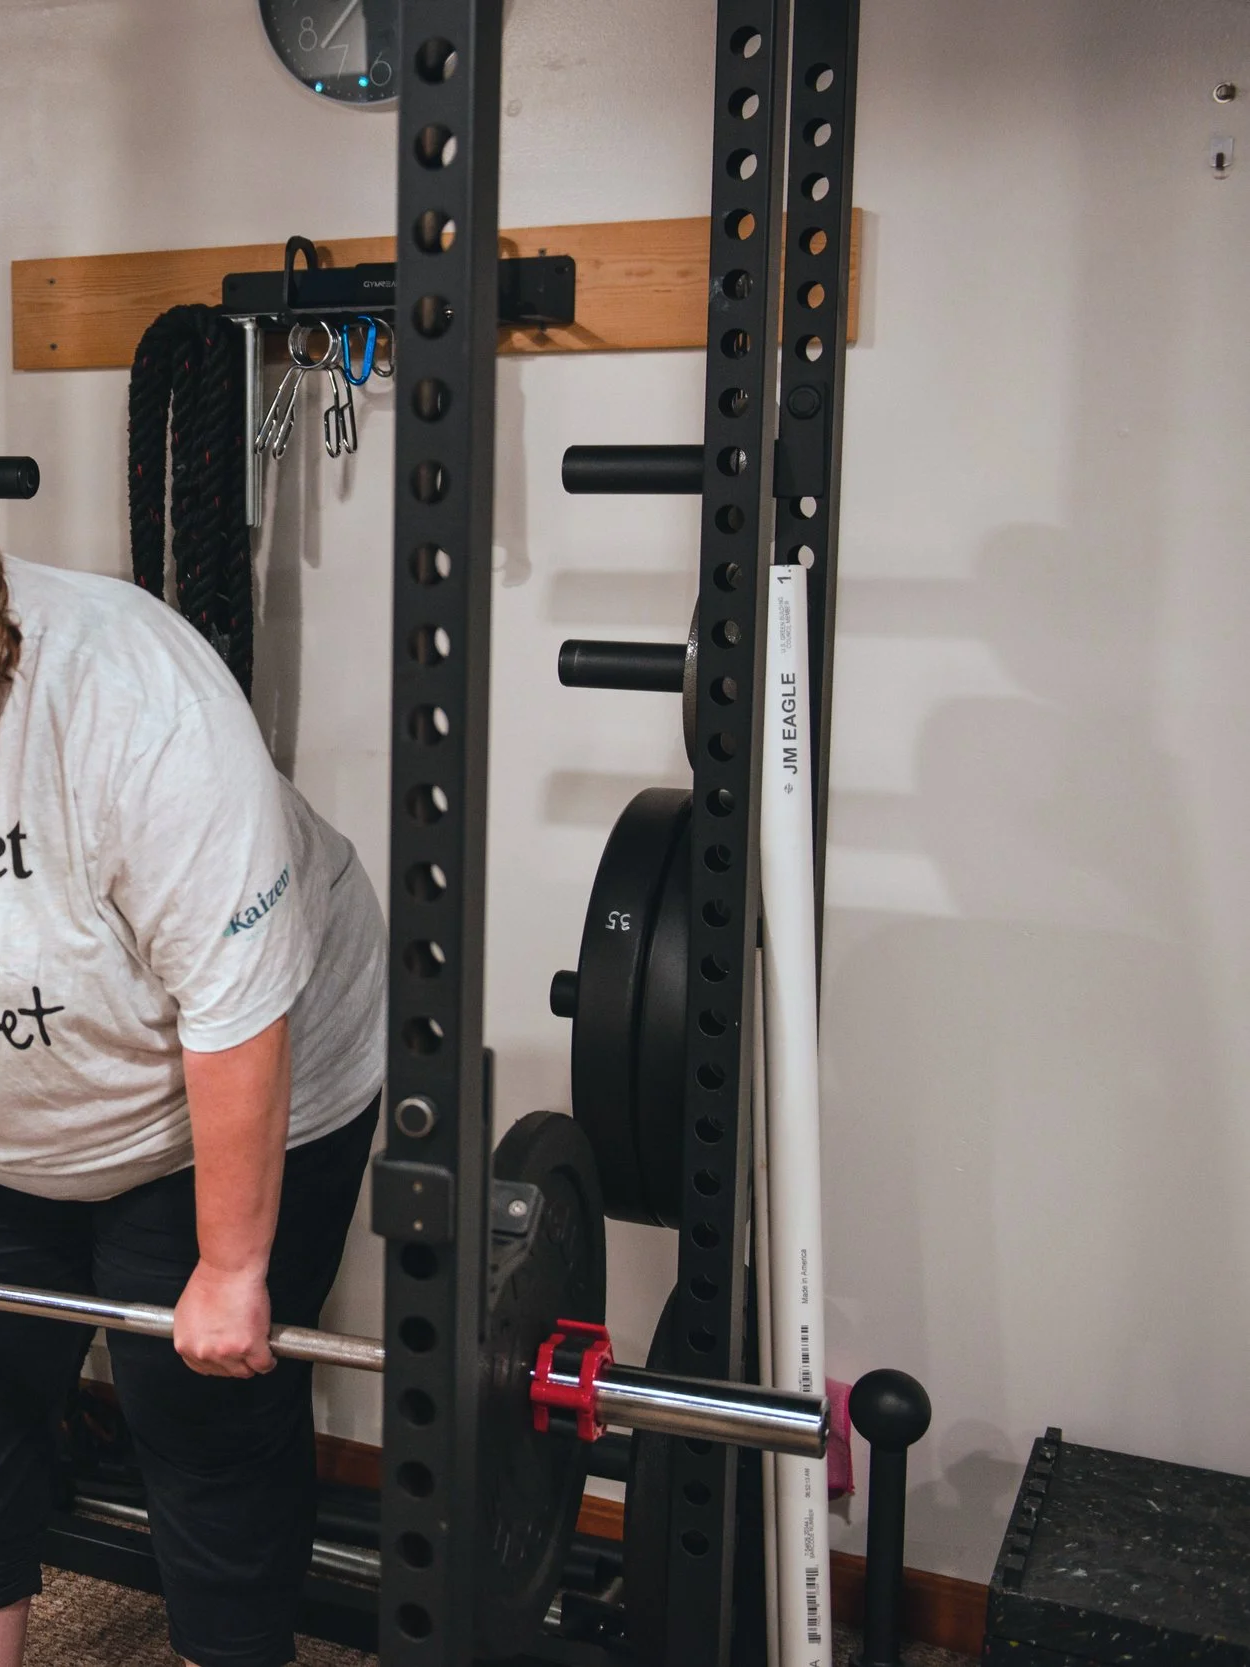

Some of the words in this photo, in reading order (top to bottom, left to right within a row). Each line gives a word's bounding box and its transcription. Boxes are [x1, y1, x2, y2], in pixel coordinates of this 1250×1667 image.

[299, 16, 318, 51] 8
[329, 44, 349, 80] 7
[370, 51, 392, 87] 6
[777, 564, 792, 584] 1.
[781, 672, 797, 741] EAGLE
[783, 747, 798, 775] JM
[230, 868, 290, 935] Kaizen
[605, 911, 631, 931] 35
[801, 1285, 809, 1304] Made
